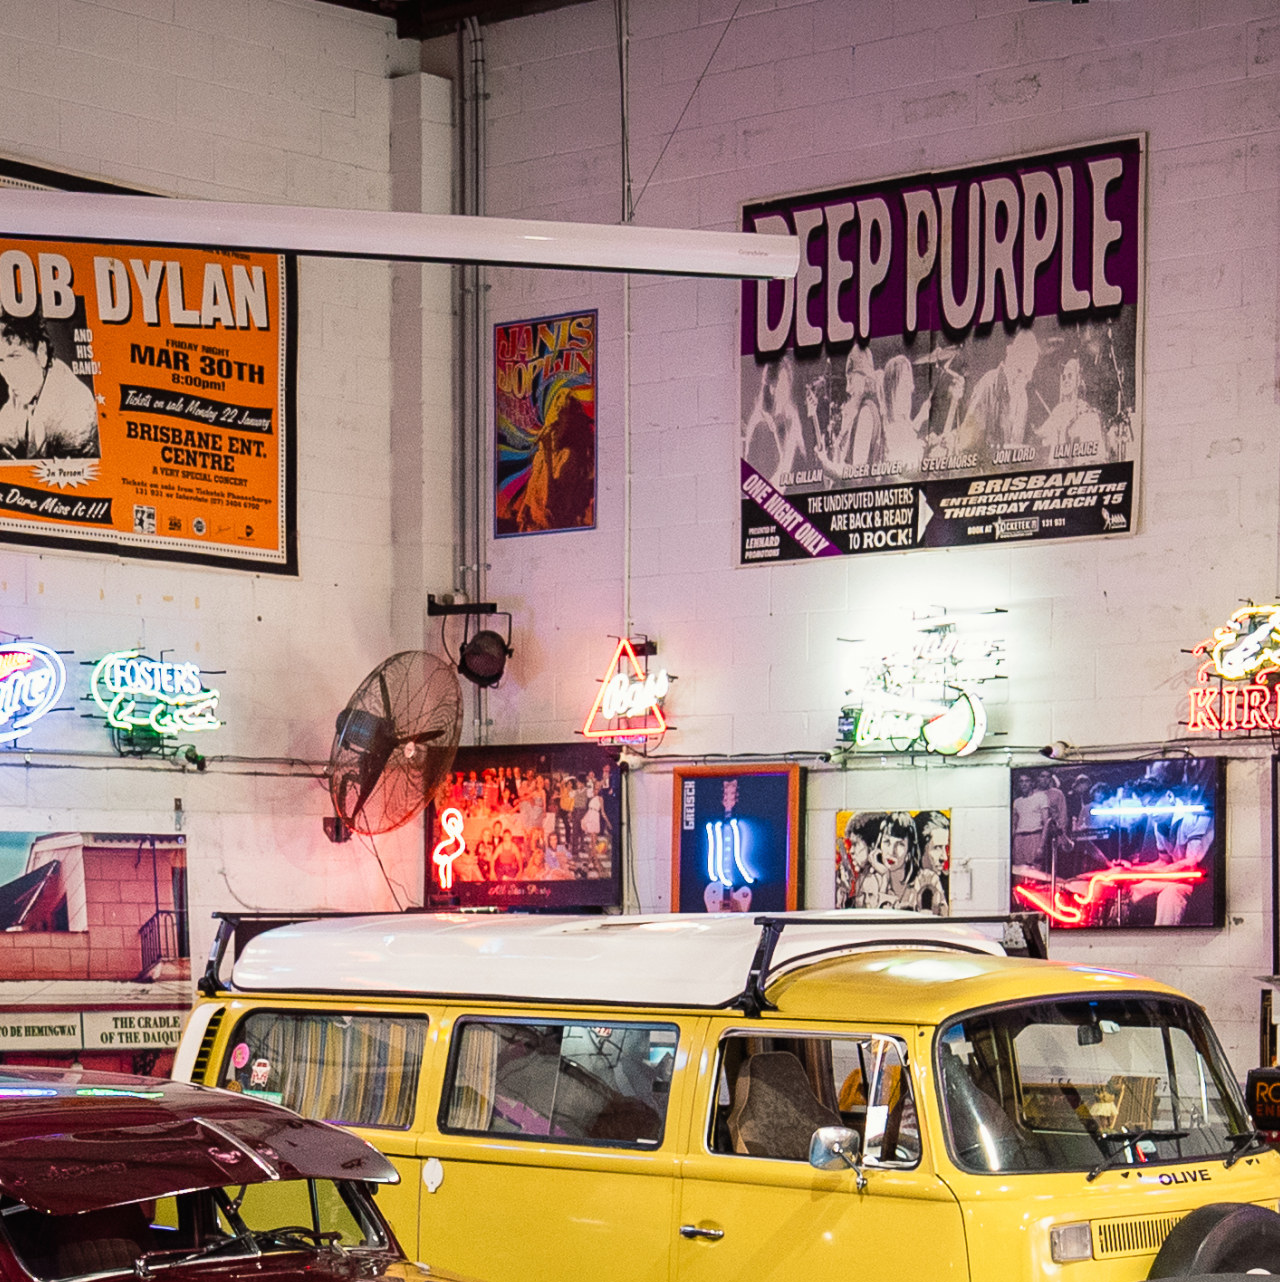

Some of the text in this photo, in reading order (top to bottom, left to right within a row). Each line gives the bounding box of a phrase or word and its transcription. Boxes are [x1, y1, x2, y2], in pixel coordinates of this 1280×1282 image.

[754, 156, 1124, 353] DEEP PURPLE
[93, 255, 270, 332] DYLAN
[72, 327, 94, 343] AND
[165, 338, 230, 358] FRIDAY NIGHT
[498, 316, 594, 362] JANIS
[75, 345, 95, 360] HIS
[129, 342, 265, 385] MAR 30TH
[71, 360, 103, 376] BAND!
[497, 350, 594, 400] JOPLIN
[171, 373, 226, 392] 8:00pm!
[124, 389, 271, 432] Tickets on sale Monday 22 January
[125, 420, 268, 459] BRISBANE ENT.
[160, 445, 236, 473] CENTRE
[921, 453, 978, 473] STEVE MORSE
[992, 447, 1036, 465] JON LORD
[58, 468, 85, 478] Person!
[151, 465, 248, 488] A VERY SPECIAL CONCERT
[795, 469, 824, 485] GILLAN
[841, 461, 903, 480] ROGER GLOVER
[967, 469, 1103, 496] BRISBANE
[742, 473, 772, 504] ONE
[807, 487, 914, 514] THE UNDISPUTED MASTERS
[939, 481, 1128, 508] ENTERTAINMENT CENTRE
[5, 488, 38, 510] Dare
[38, 499, 71, 517] Miss
[71, 501, 86, 517] It
[763, 492, 804, 533] NIGHT
[943, 493, 1125, 520] THURSDAY MARCH 15
[829, 507, 915, 532] ARE BACK & READY
[794, 521, 830, 557] ONLY
[848, 526, 913, 551] TO ROCK!
[683, 780, 696, 831] GRETSCH
[9, 1025, 24, 1038] DE
[23, 1023, 79, 1038] HEMINGWAY
[112, 1015, 181, 1030] THE CRADLE
[100, 1031, 142, 1045] OF THE
[1158, 1168, 1212, 1186] OLIVE
